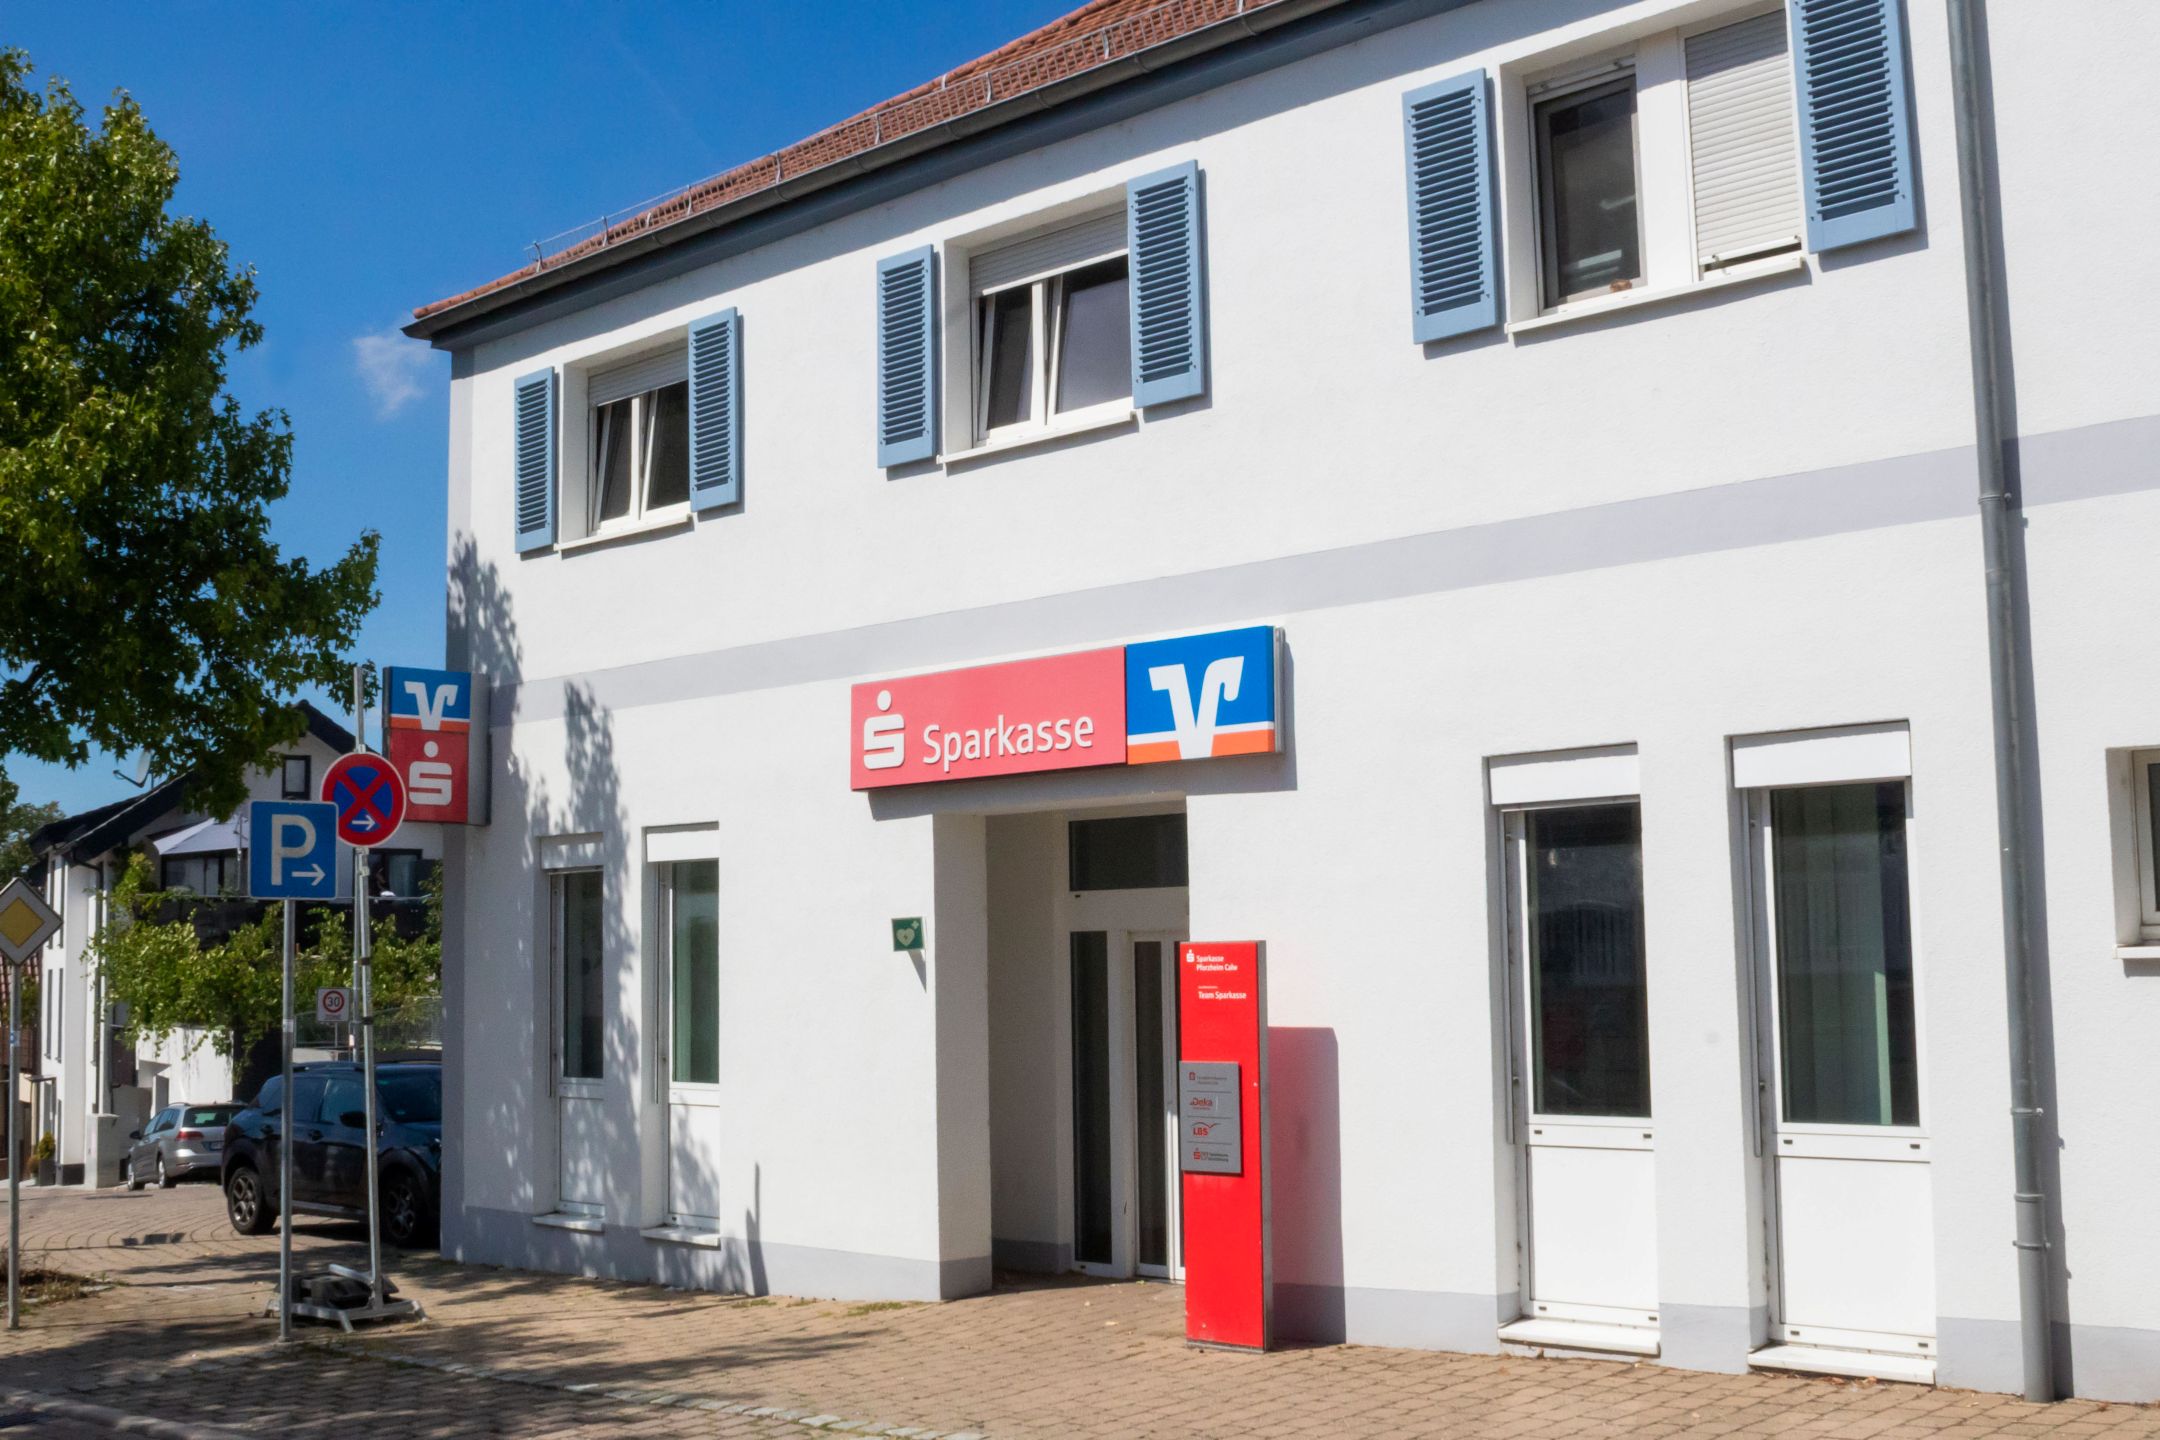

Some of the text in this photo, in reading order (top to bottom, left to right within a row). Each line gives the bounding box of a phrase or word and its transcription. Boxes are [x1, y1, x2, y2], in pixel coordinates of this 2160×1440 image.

[922, 714, 1095, 773] Sparkasse
[271, 814, 317, 886] P
[1196, 955, 1224, 963] Sparkasse
[1198, 991, 1247, 1000] Team Sparkasse
[327, 996, 340, 1007] 30
[1193, 1127, 1208, 1136] LBS
